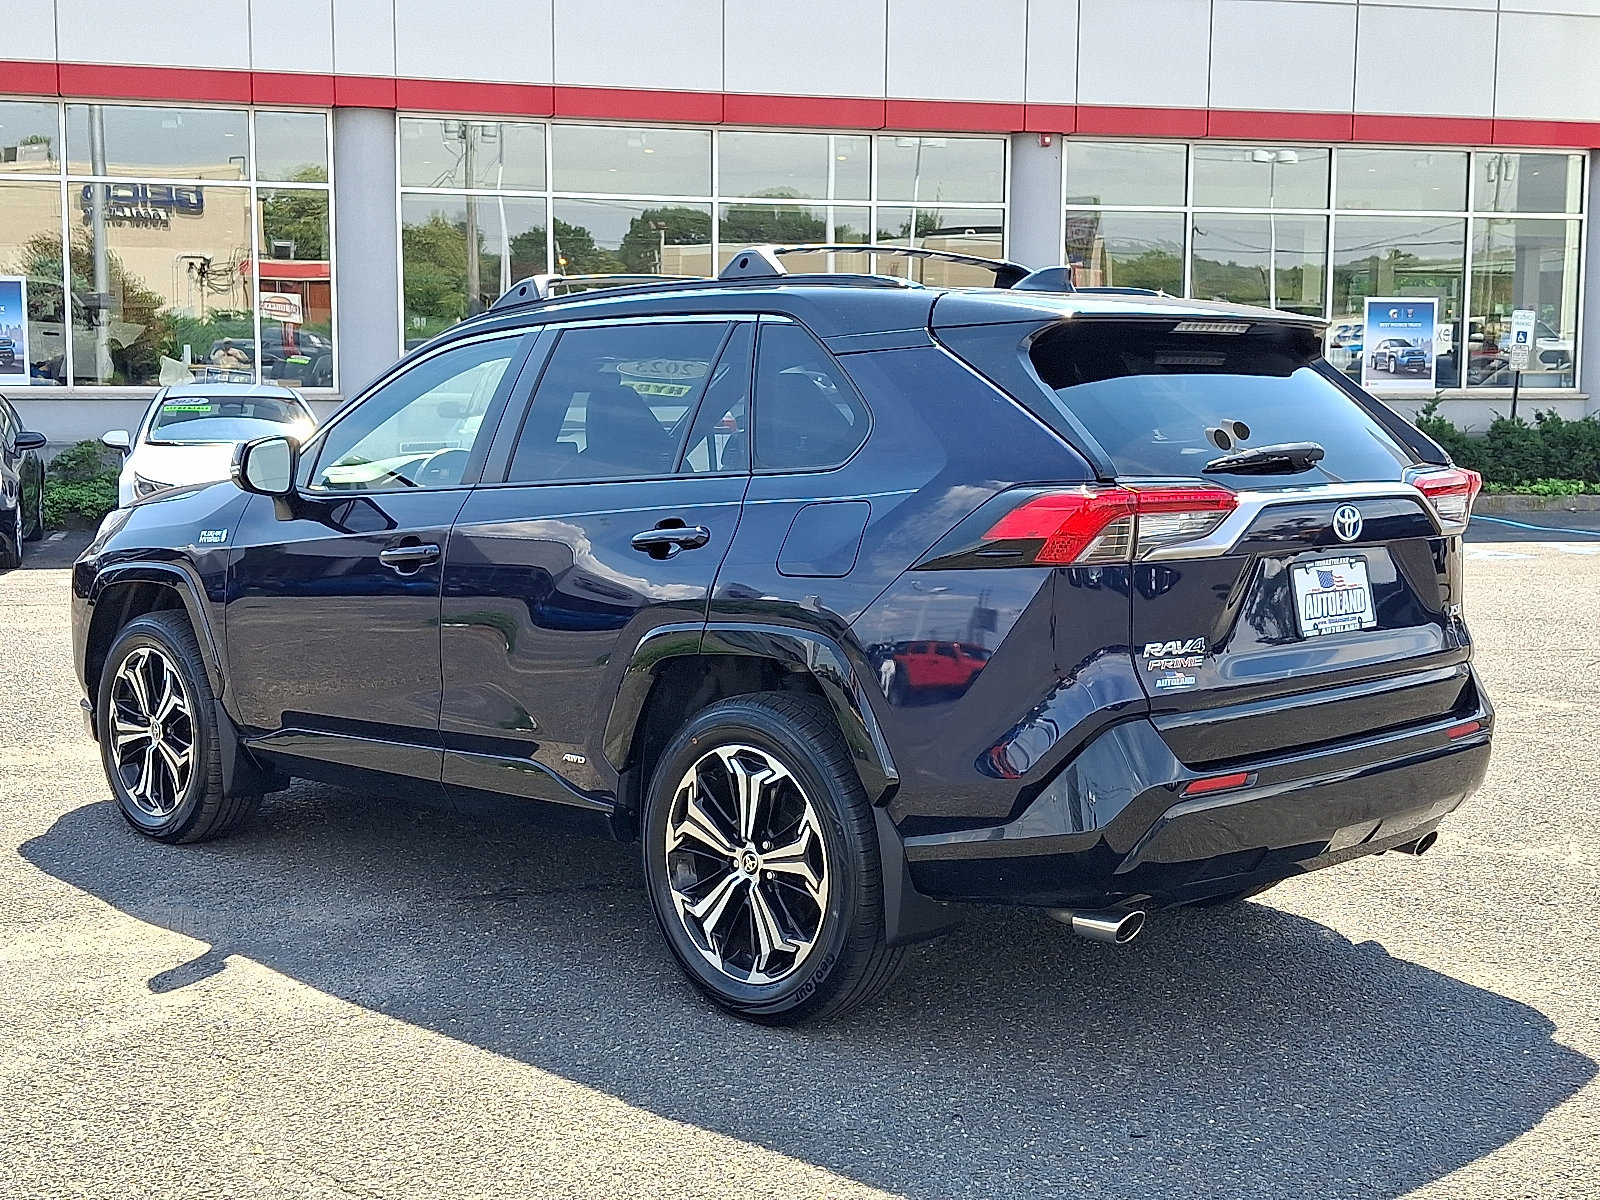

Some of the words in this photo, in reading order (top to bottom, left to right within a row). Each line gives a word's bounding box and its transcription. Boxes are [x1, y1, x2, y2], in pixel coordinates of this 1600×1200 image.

[1305, 588, 1366, 620] AUTOLAND
[1143, 637, 1205, 658] RAV4
[1147, 656, 1204, 672] PRIME
[562, 753, 586, 764] AWD
